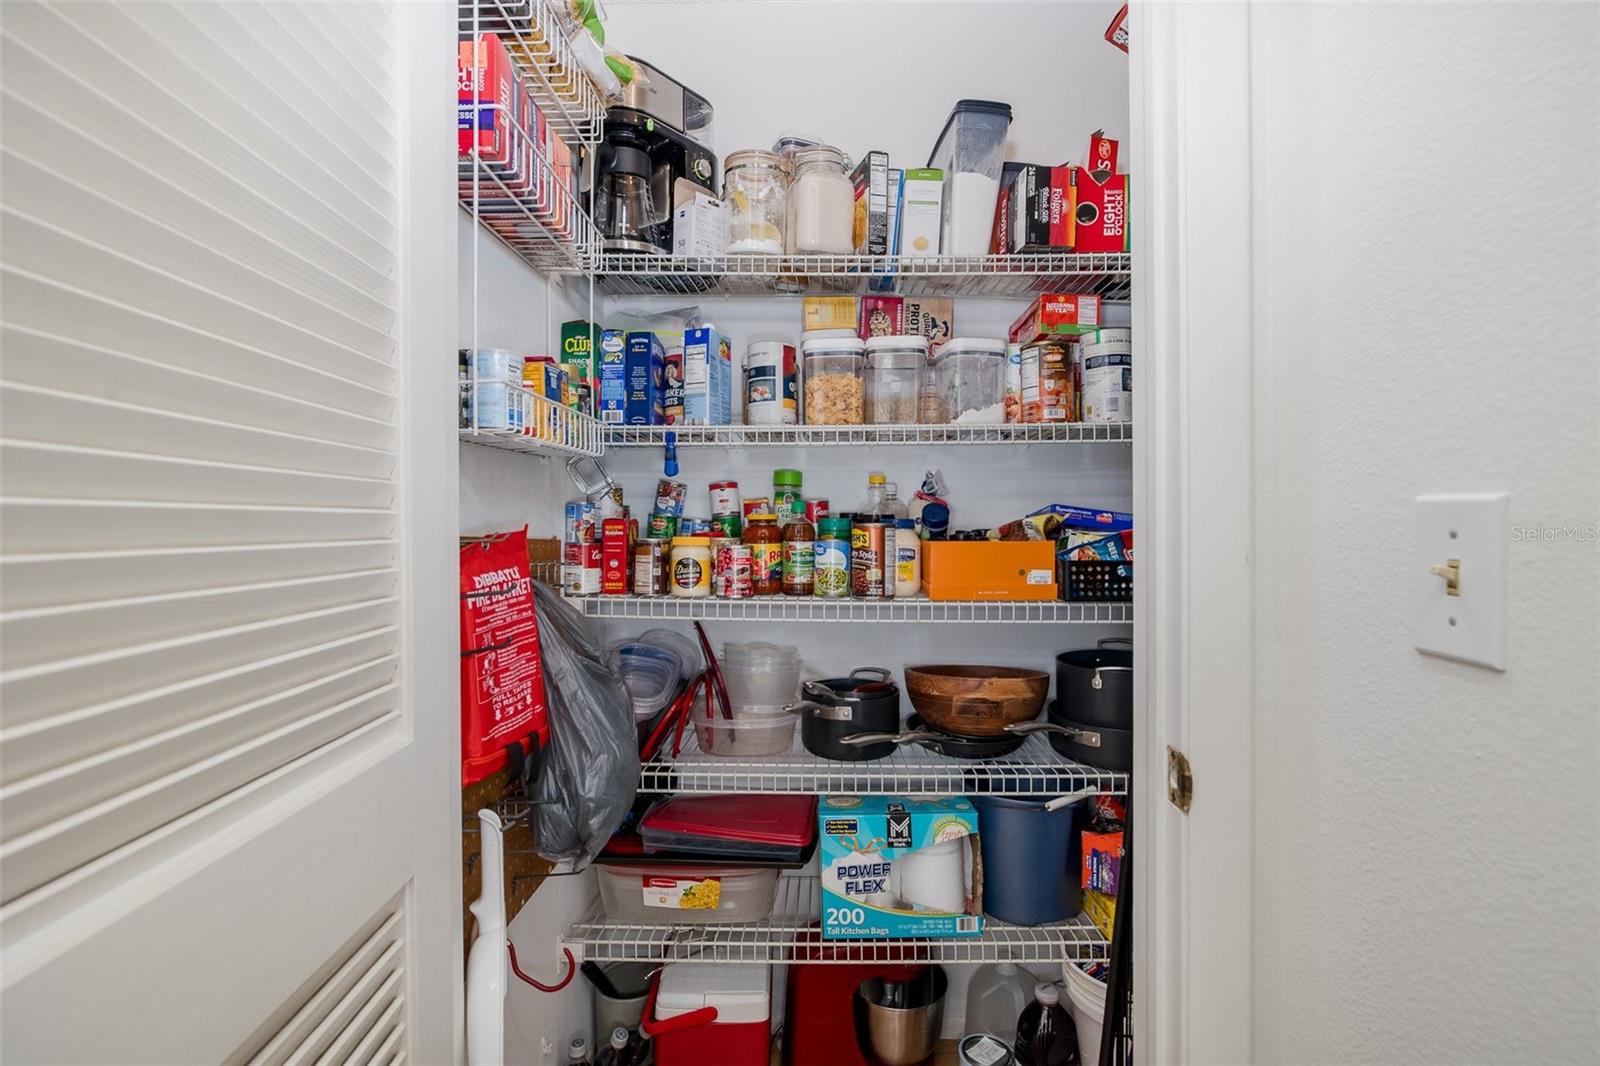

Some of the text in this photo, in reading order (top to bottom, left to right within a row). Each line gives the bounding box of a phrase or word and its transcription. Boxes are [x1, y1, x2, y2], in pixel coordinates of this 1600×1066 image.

[1052, 188, 1063, 225] Folgers
[1104, 195, 1115, 236] EIGHT
[1115, 195, 1123, 235] O'CLOCK
[473, 566, 521, 589] DIBBATU
[491, 577, 531, 602] BLANKET
[492, 692, 513, 704] PULL
[493, 688, 532, 710] TO RELEASE
[837, 863, 891, 880] POWER
[846, 879, 885, 895] FLEX
[827, 908, 865, 926] 200
[826, 927, 840, 936] Tall
[841, 927, 870, 936] Kitchen
[871, 927, 889, 937] Bags
